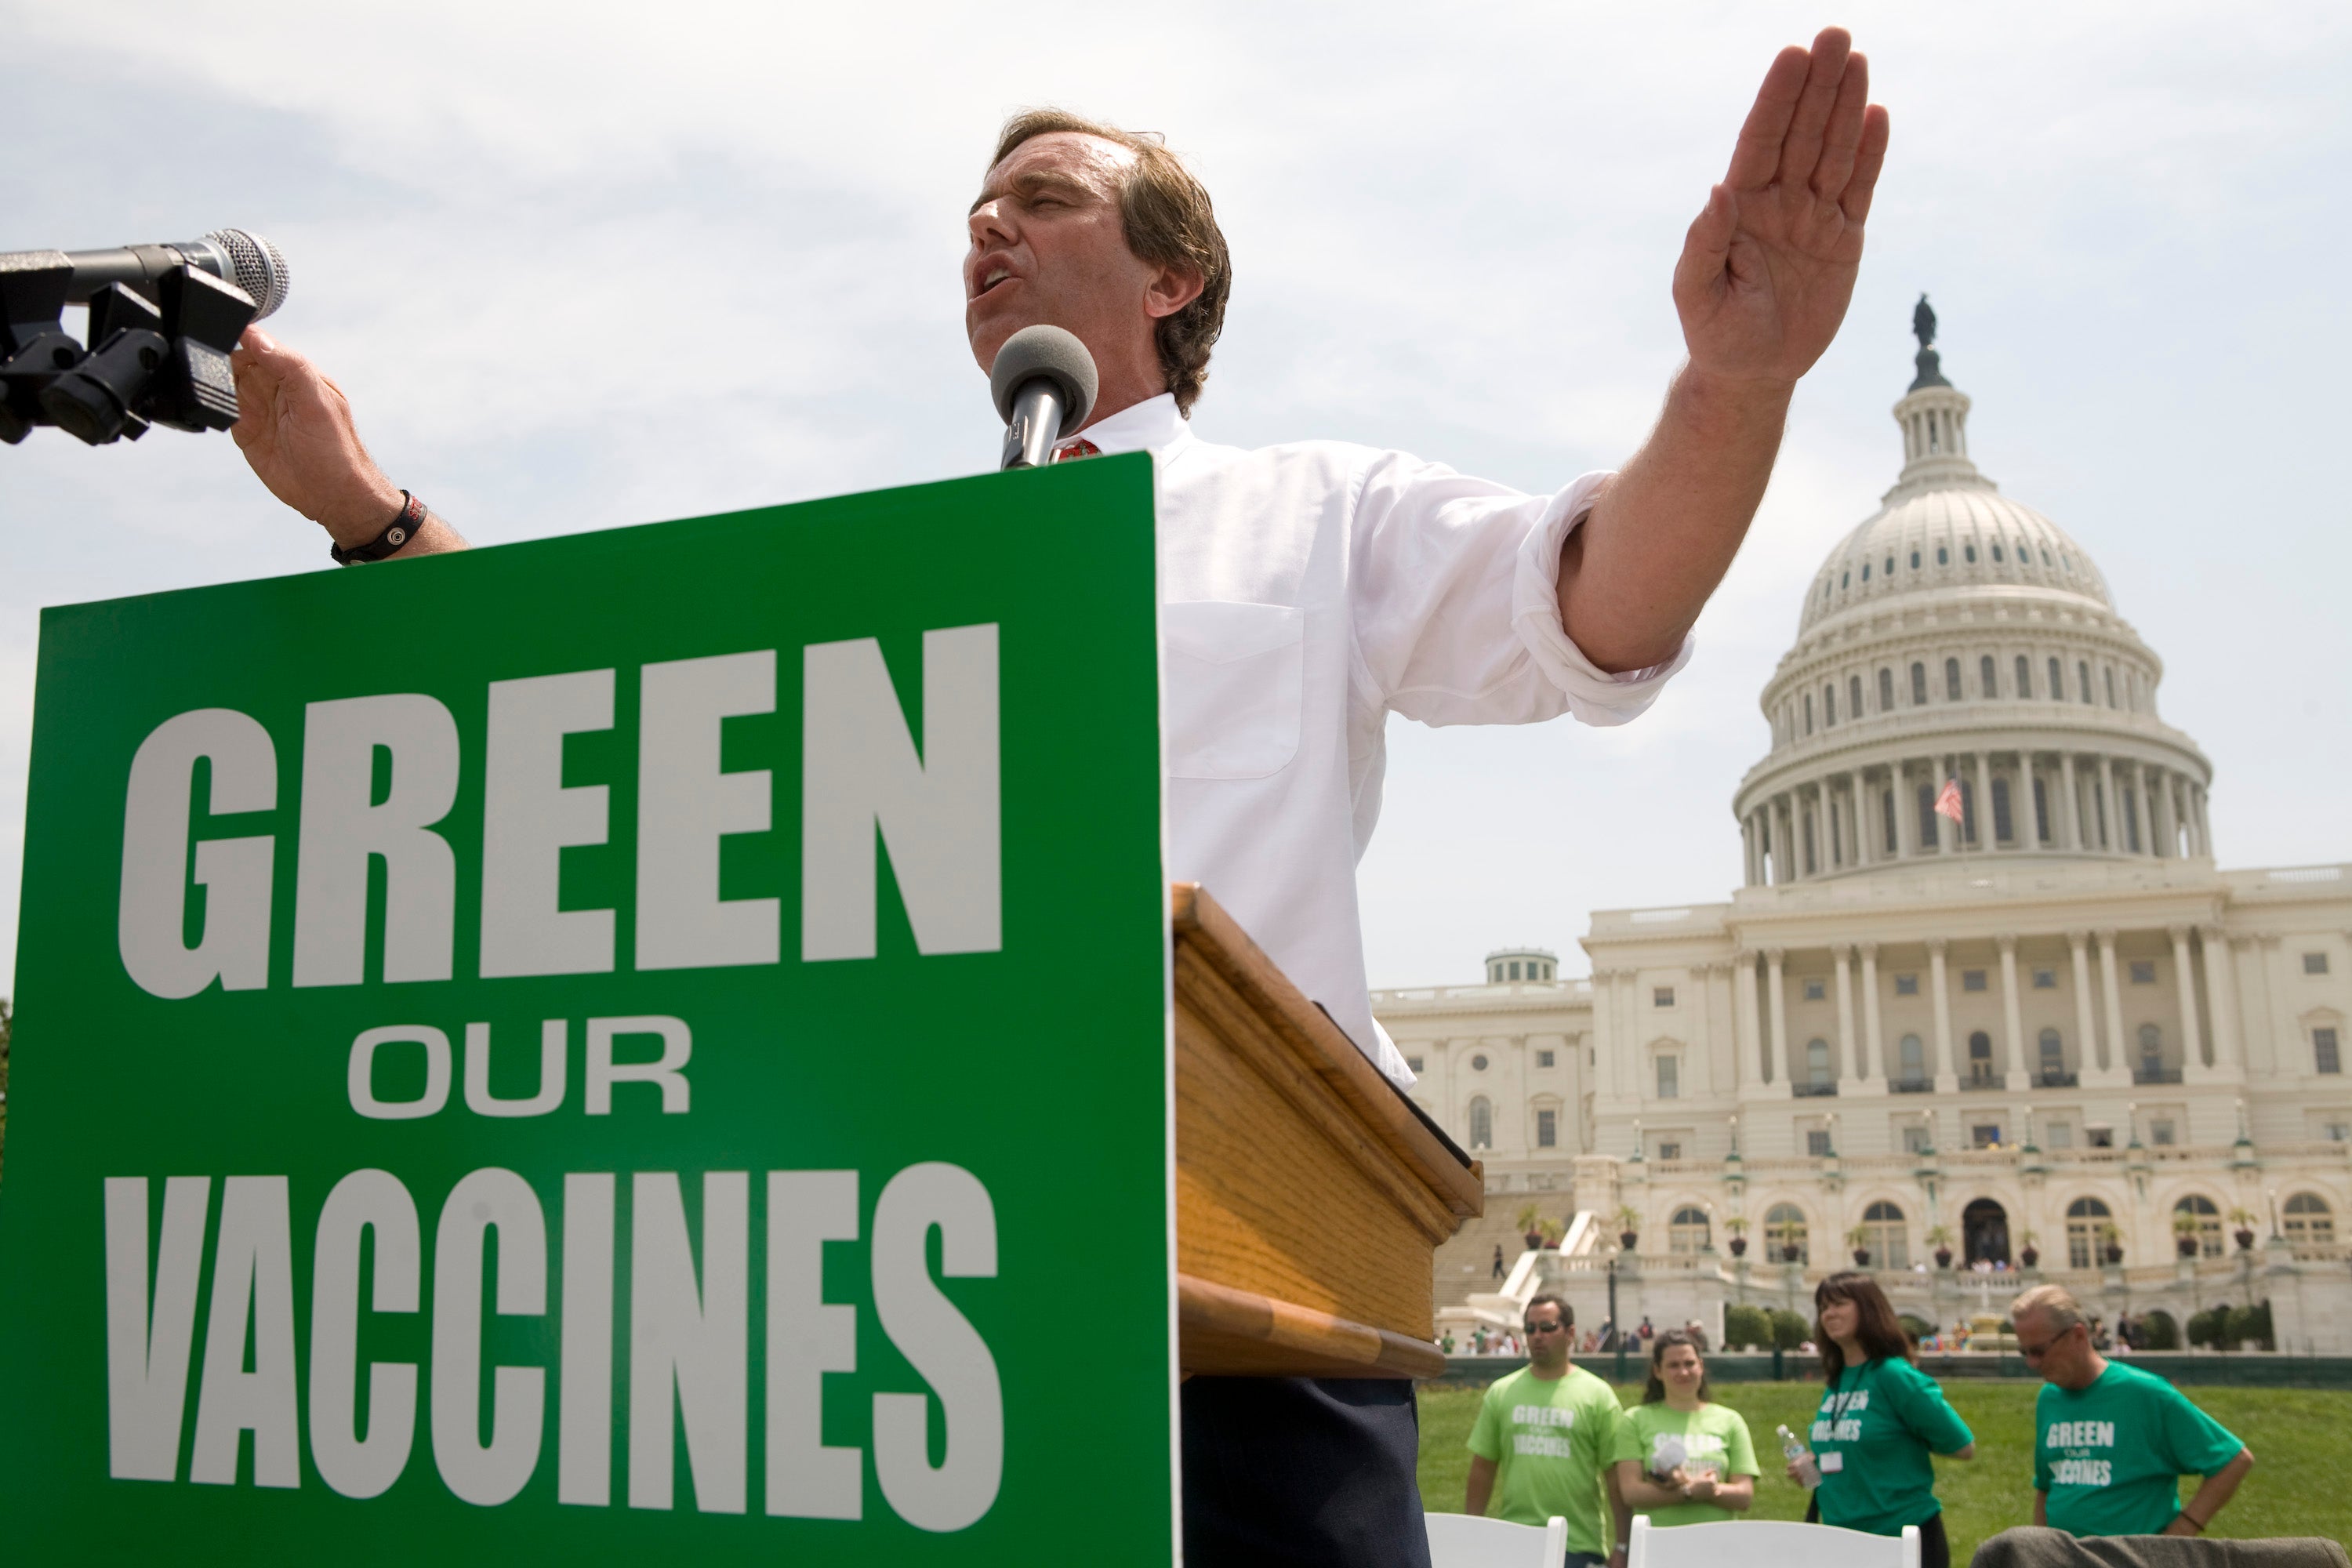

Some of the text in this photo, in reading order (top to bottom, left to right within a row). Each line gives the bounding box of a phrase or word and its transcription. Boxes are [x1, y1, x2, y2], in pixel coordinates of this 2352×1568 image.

[118, 622, 1003, 1000] GREEN
[347, 1015, 691, 1120] OUR
[104, 1162, 1004, 1532] VACCINES
[1512, 1404, 1574, 1428] GREEN
[2046, 1421, 2114, 1448] GREEN
